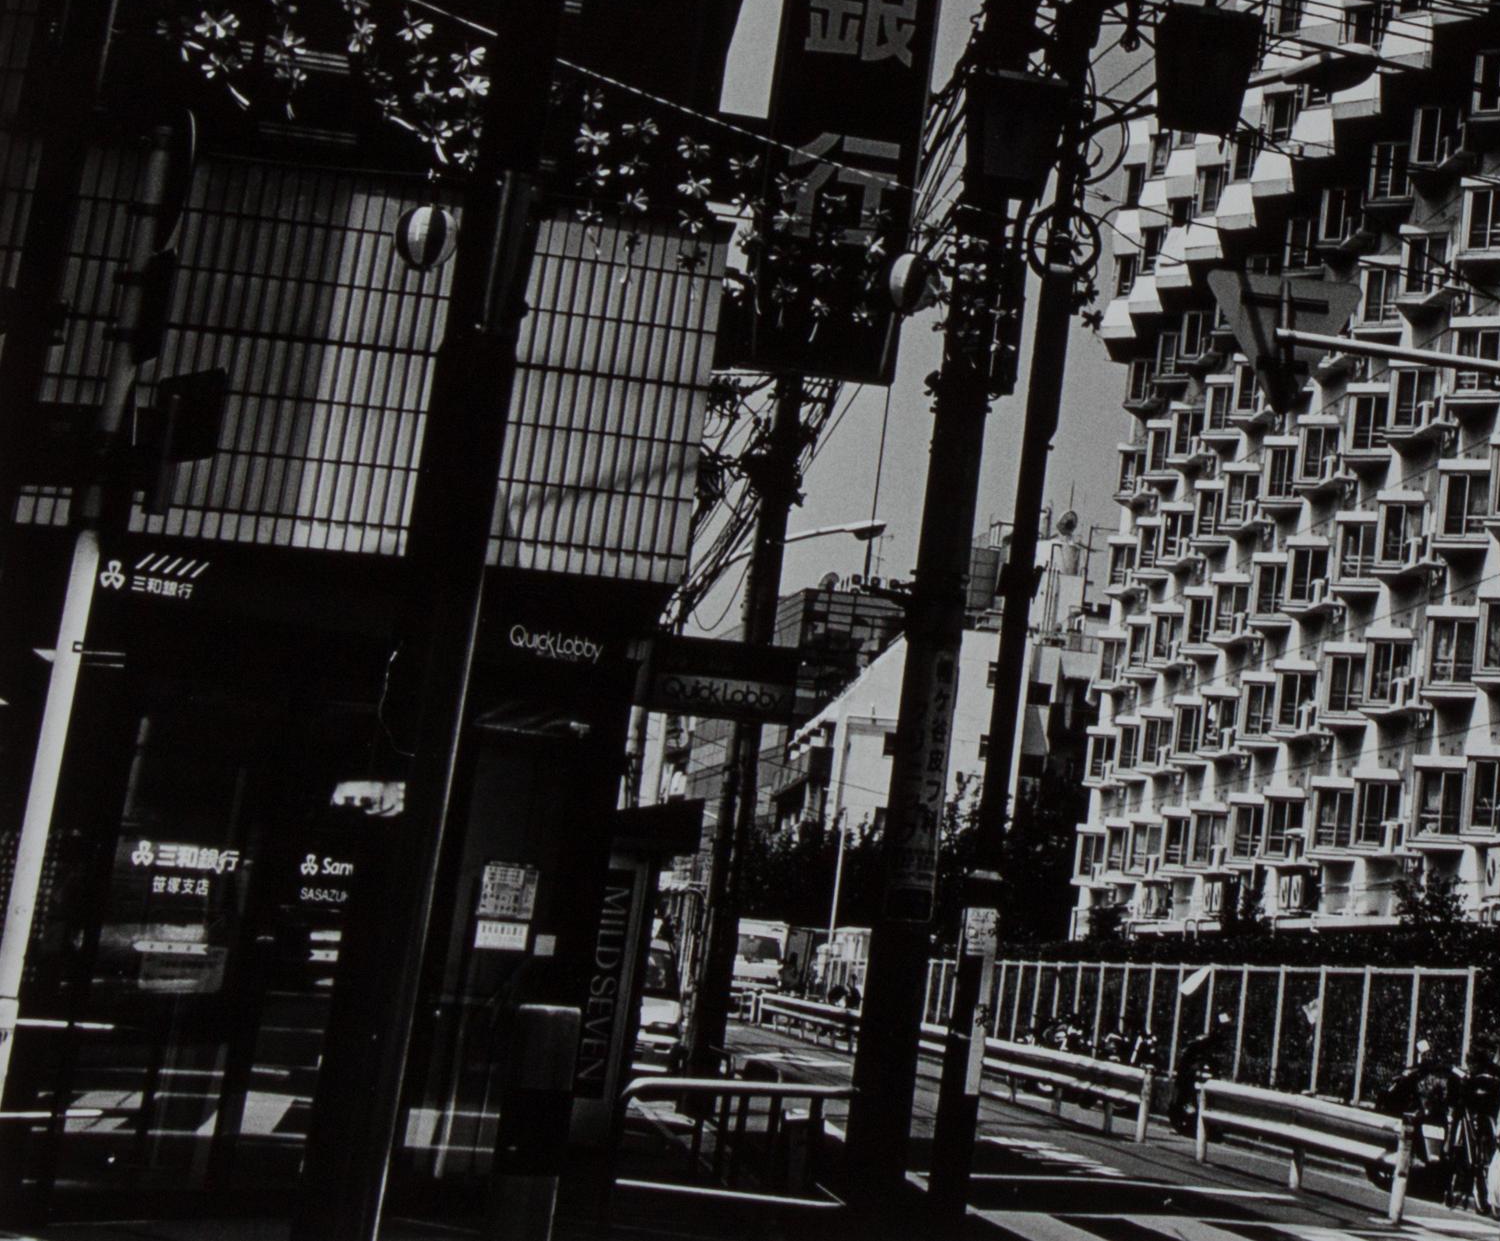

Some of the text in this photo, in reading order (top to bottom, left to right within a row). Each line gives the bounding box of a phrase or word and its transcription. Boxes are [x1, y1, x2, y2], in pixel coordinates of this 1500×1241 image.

[131, 575, 194, 600] 三和銀行
[510, 624, 604, 665] Quick Lobby
[662, 676, 784, 710] Quick Lobby
[155, 843, 240, 874] 三和銀行
[152, 874, 210, 897] 笹塚支店
[577, 885, 630, 1080] MILD SEVEN
